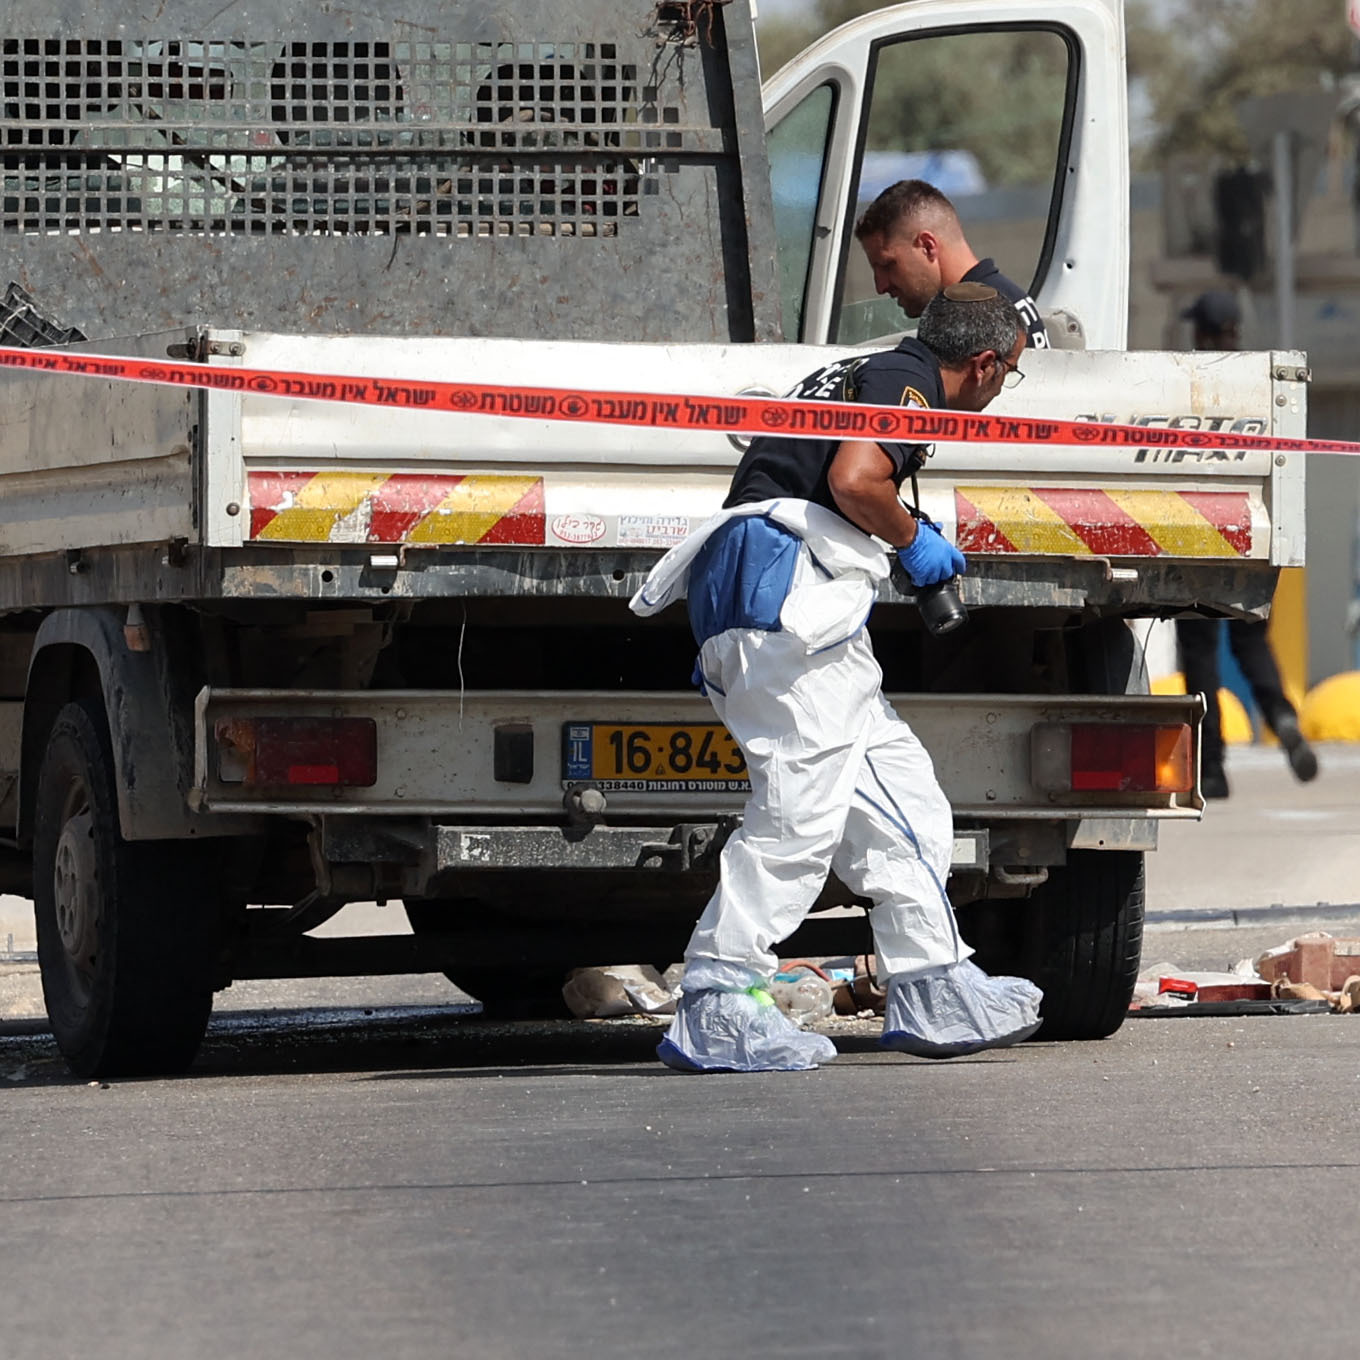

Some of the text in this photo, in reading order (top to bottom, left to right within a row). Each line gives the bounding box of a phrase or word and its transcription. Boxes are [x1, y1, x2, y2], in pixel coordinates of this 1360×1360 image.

[62, 355, 126, 376] ישראל
[168, 369, 436, 406] משטרת ישראל אין מעבר
[478, 392, 747, 425] משטרת ישראל אין מעבר
[789, 409, 1059, 440] משטרת ישראל אין מעבר
[1101, 426, 1179, 445] משטרת
[573, 741, 588, 762] IL
[647, 780, 686, 791] רחובות
[688, 780, 726, 791] מוטורס
